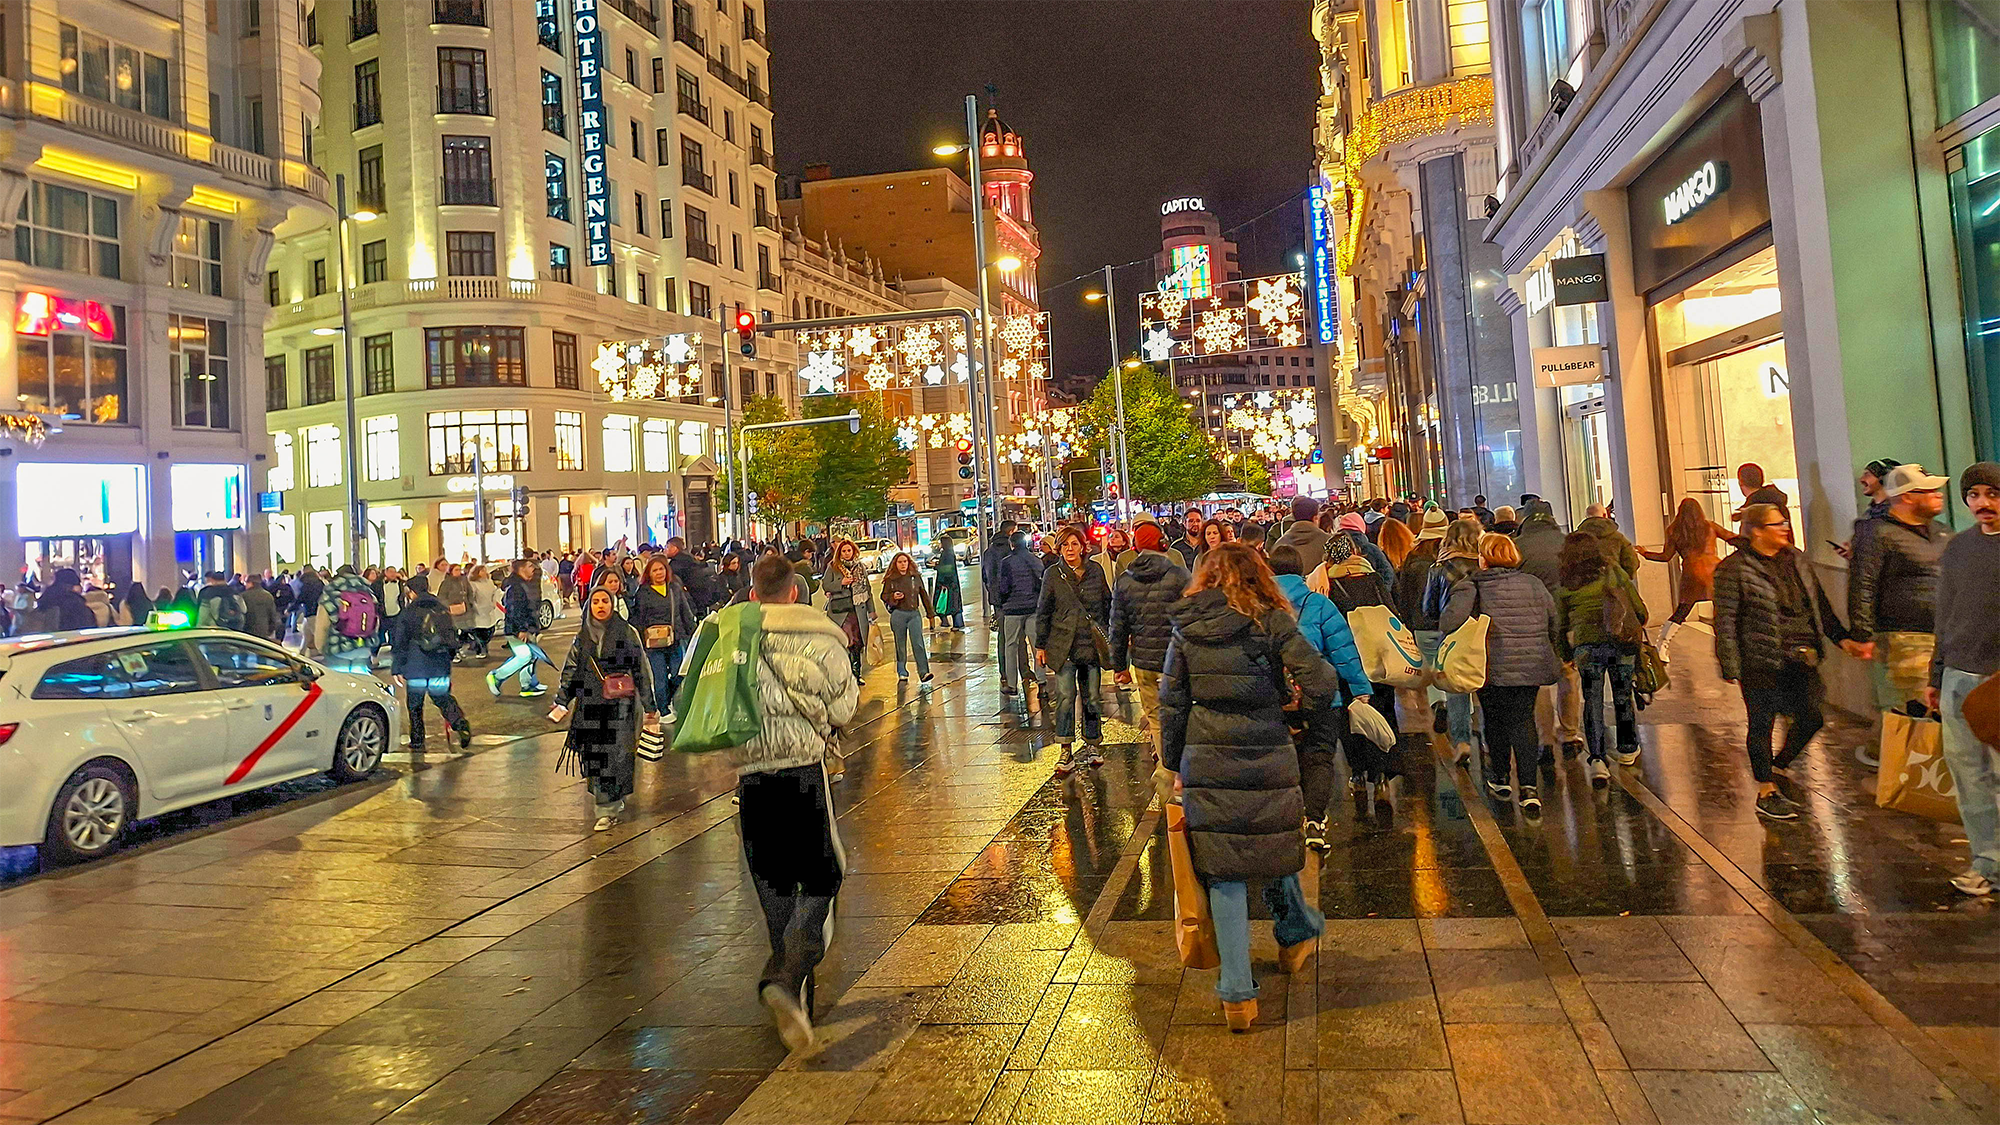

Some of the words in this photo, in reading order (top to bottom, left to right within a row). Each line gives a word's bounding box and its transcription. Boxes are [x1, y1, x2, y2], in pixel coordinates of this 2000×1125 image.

[575, 0, 598, 100] HOTEL
[582, 111, 608, 262] REGENTE
[1161, 198, 1206, 215] CAPITOL
[1311, 187, 1326, 241] HOTEL
[1663, 161, 1717, 226] MANGO
[1315, 246, 1333, 341] ATLANTICO
[1556, 274, 1602, 287] MANGO
[1541, 360, 1596, 373] PULL&BEAR
